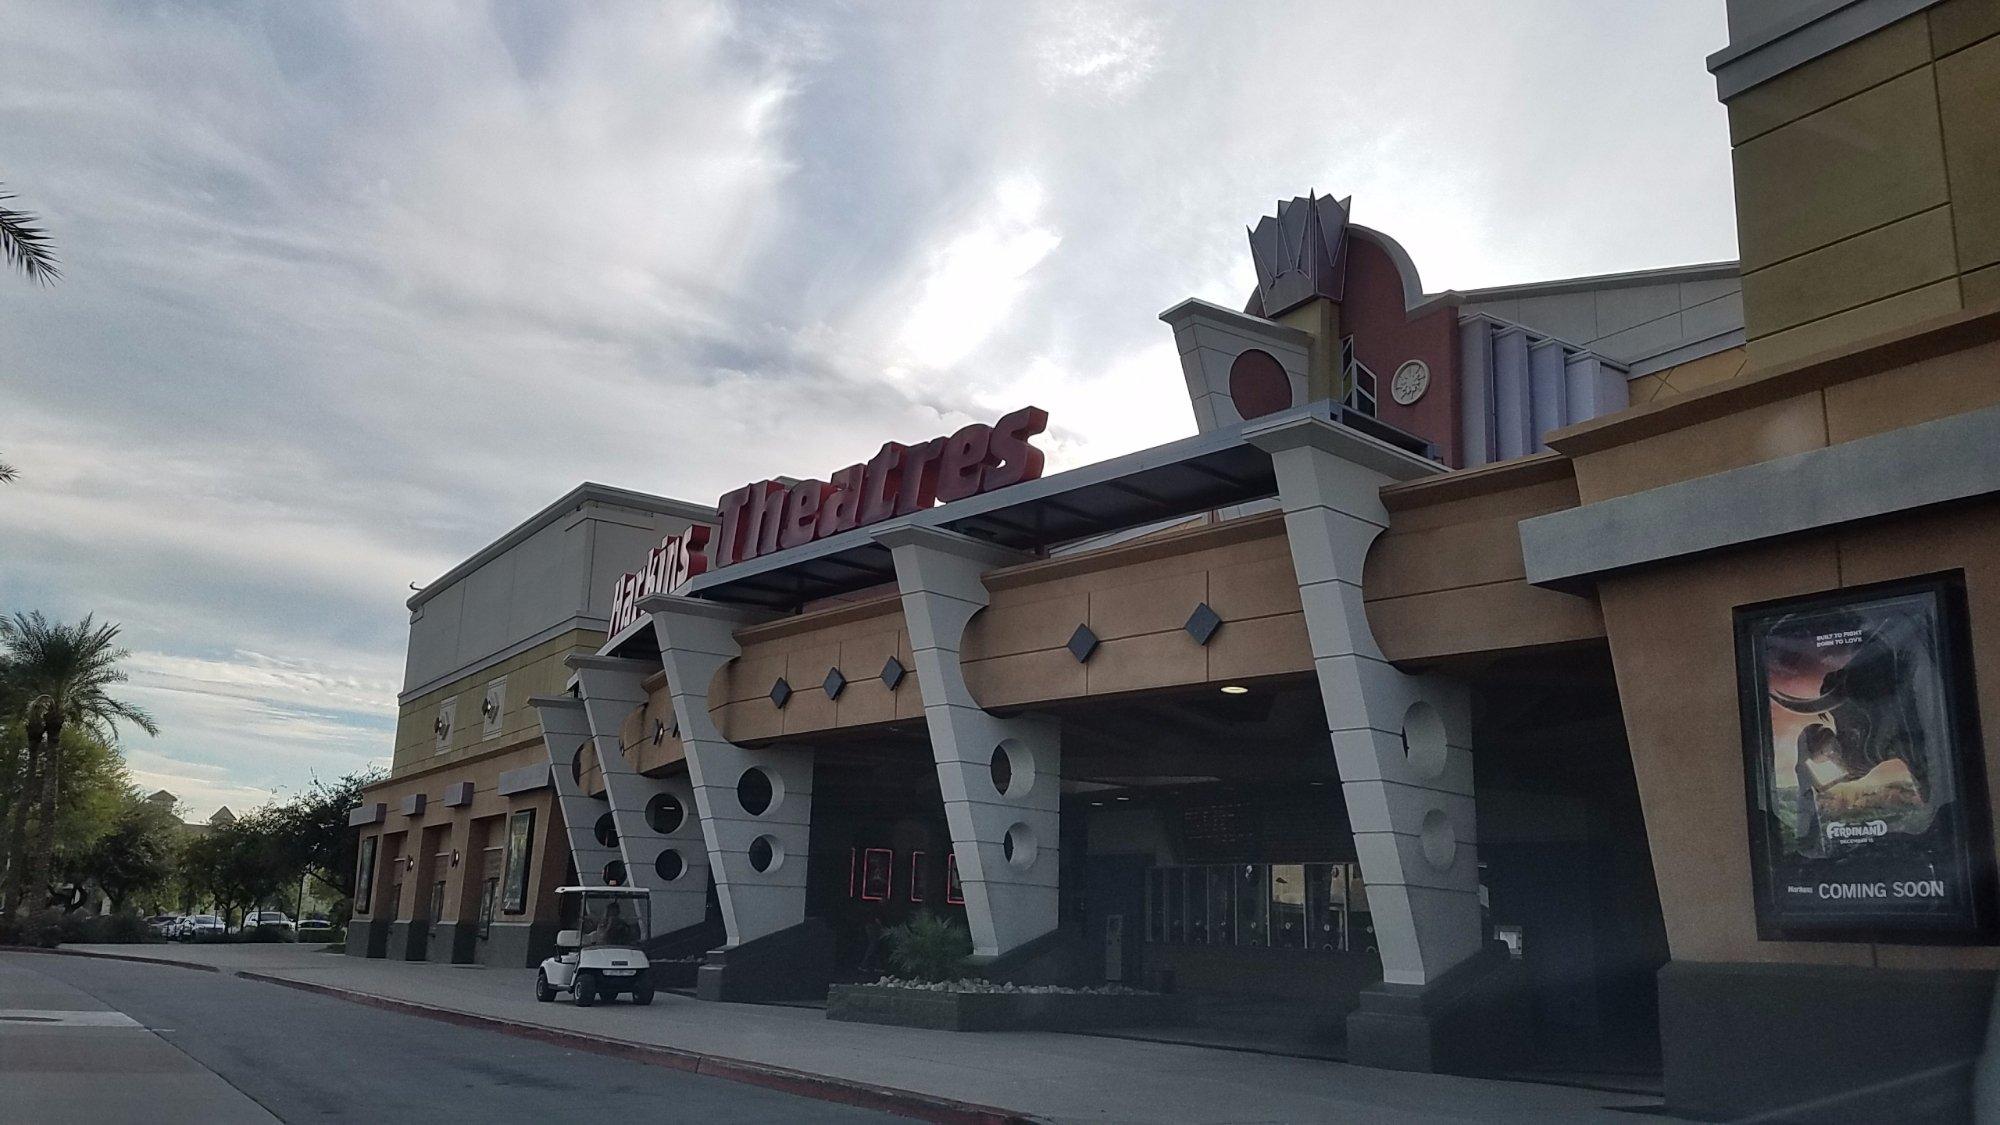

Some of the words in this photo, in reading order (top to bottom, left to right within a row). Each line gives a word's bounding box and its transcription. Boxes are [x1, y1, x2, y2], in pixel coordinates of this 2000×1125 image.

[606, 524, 711, 641] Harkins
[716, 406, 1048, 567] Theatres
[1826, 820, 1887, 838] FERDINAND
[1818, 882, 1886, 899] COMING
[1892, 881, 1944, 897] SOON
